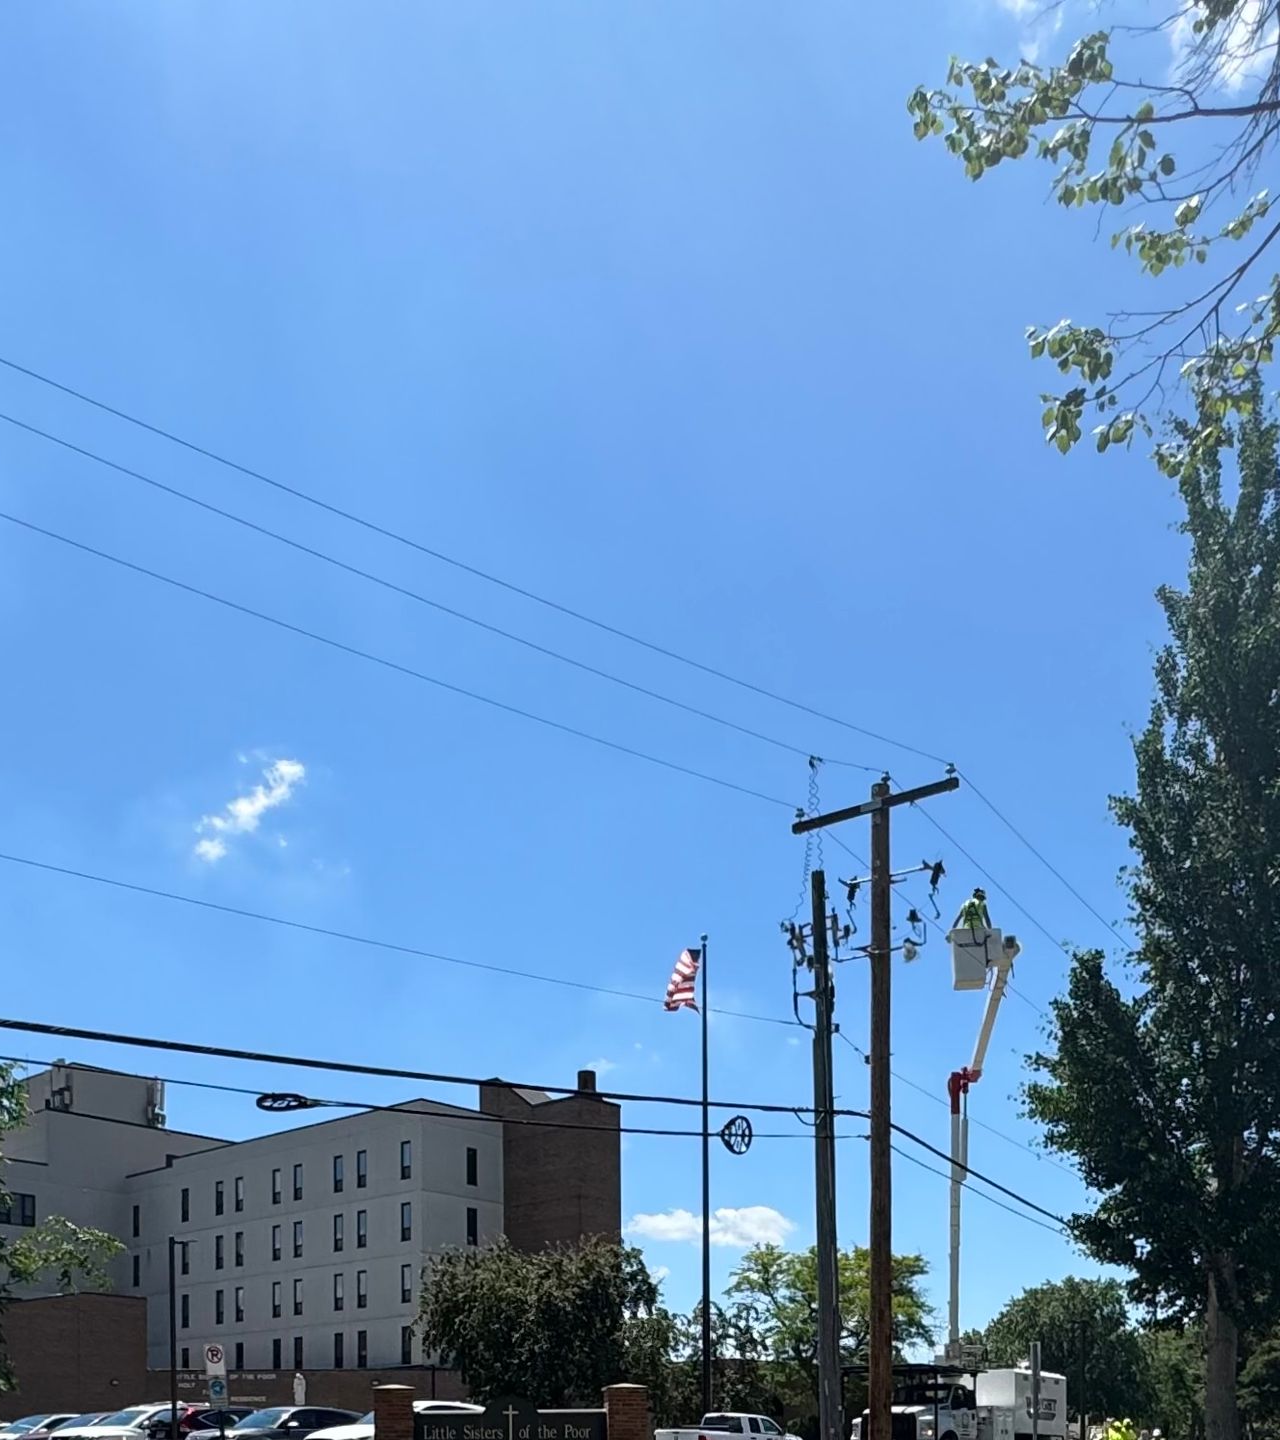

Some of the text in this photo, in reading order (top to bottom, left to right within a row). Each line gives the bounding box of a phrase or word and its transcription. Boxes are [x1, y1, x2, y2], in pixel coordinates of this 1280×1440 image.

[423, 1424, 591, 1440] Little Sisters of the Poor
